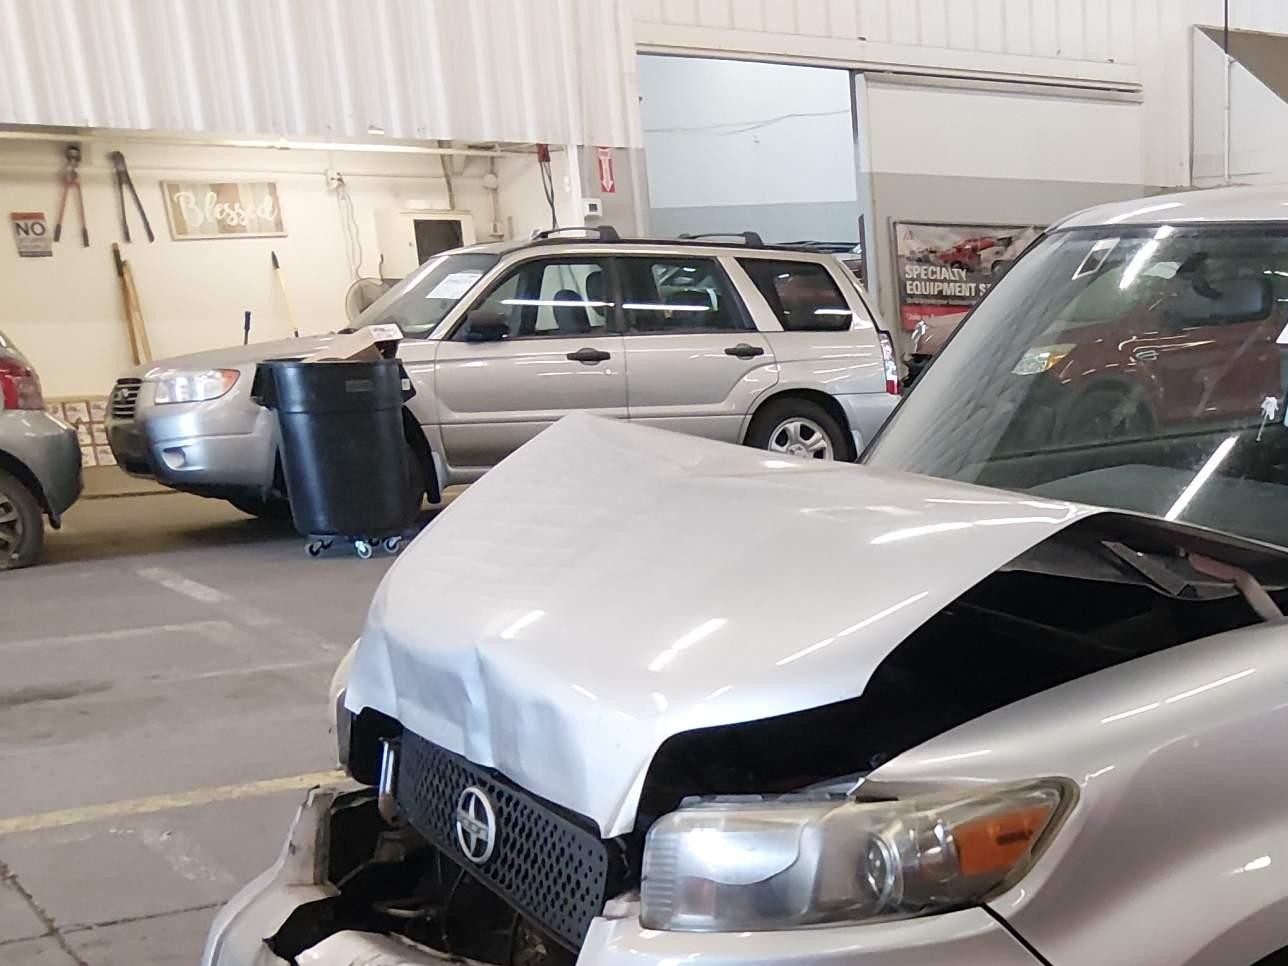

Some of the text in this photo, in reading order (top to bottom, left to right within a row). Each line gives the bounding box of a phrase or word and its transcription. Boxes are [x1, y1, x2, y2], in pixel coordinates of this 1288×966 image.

[174, 191, 278, 227] Blessed
[15, 222, 46, 236] NO
[905, 265, 967, 280] SPECIALTY
[906, 281, 976, 296] EQUIPMENT
